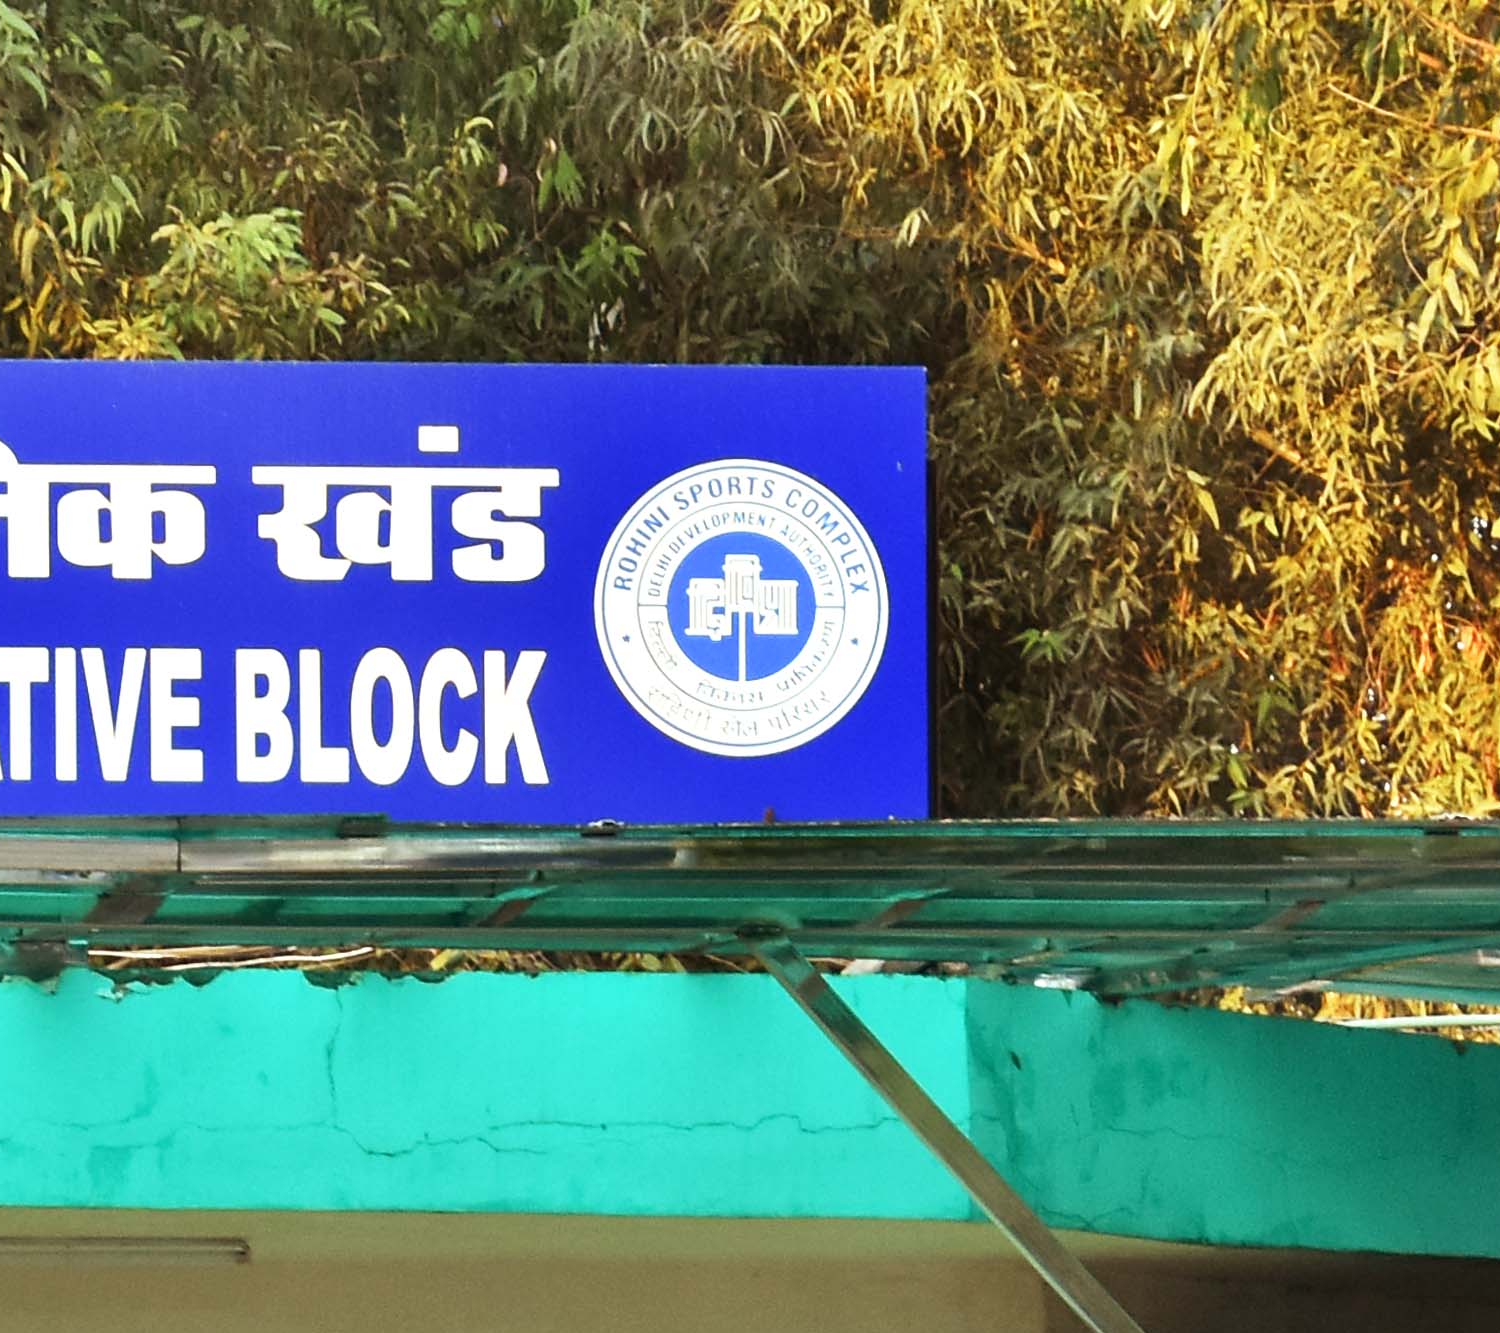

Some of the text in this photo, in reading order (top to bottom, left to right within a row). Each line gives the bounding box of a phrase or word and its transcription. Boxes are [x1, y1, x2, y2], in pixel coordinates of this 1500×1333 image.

[252, 426, 559, 581] खंड
[613, 475, 870, 595] ROHINI SPORTS COMPLEX
[648, 511, 835, 598] DELHI DEVELOPMENT AUTHORITY
[236, 648, 549, 785] BLOCK
